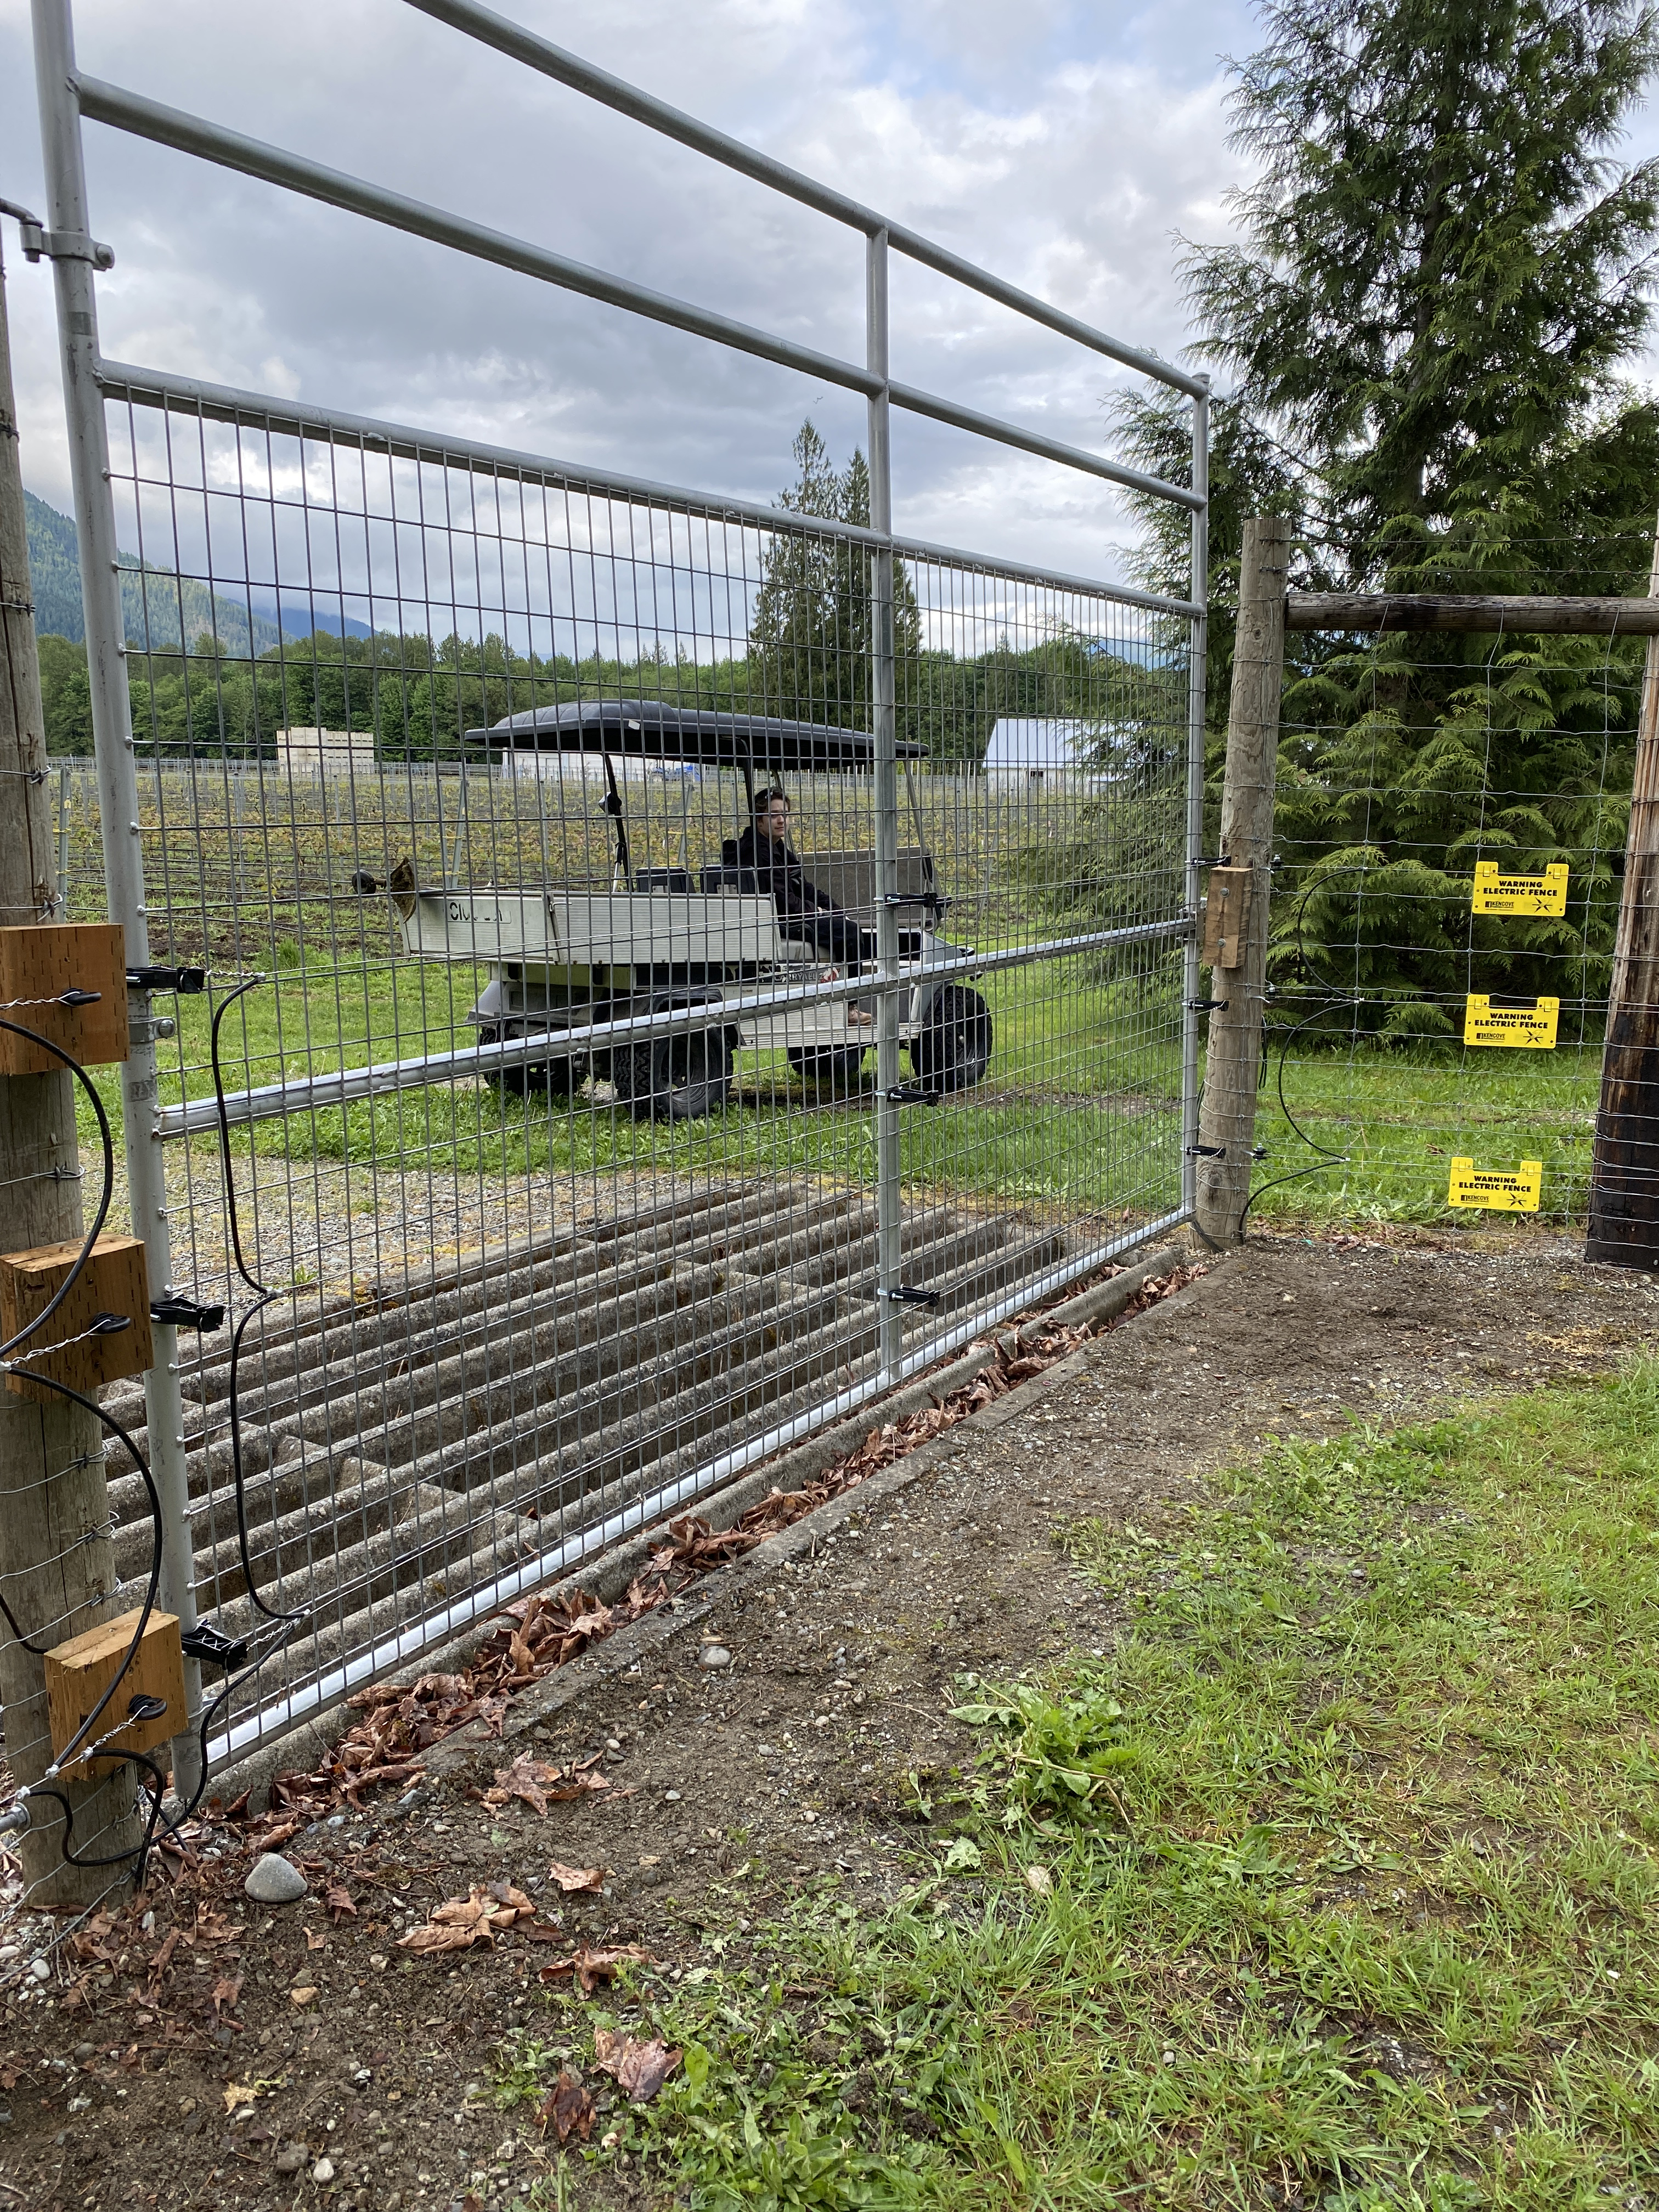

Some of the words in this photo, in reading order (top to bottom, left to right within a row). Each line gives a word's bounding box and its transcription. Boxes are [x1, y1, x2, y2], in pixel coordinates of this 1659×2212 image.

[1483, 887, 1525, 895] ELECTRIC
[1475, 1019, 1516, 1028] ELECTRIC
[1459, 1182, 1500, 1190] ELECTRIC
